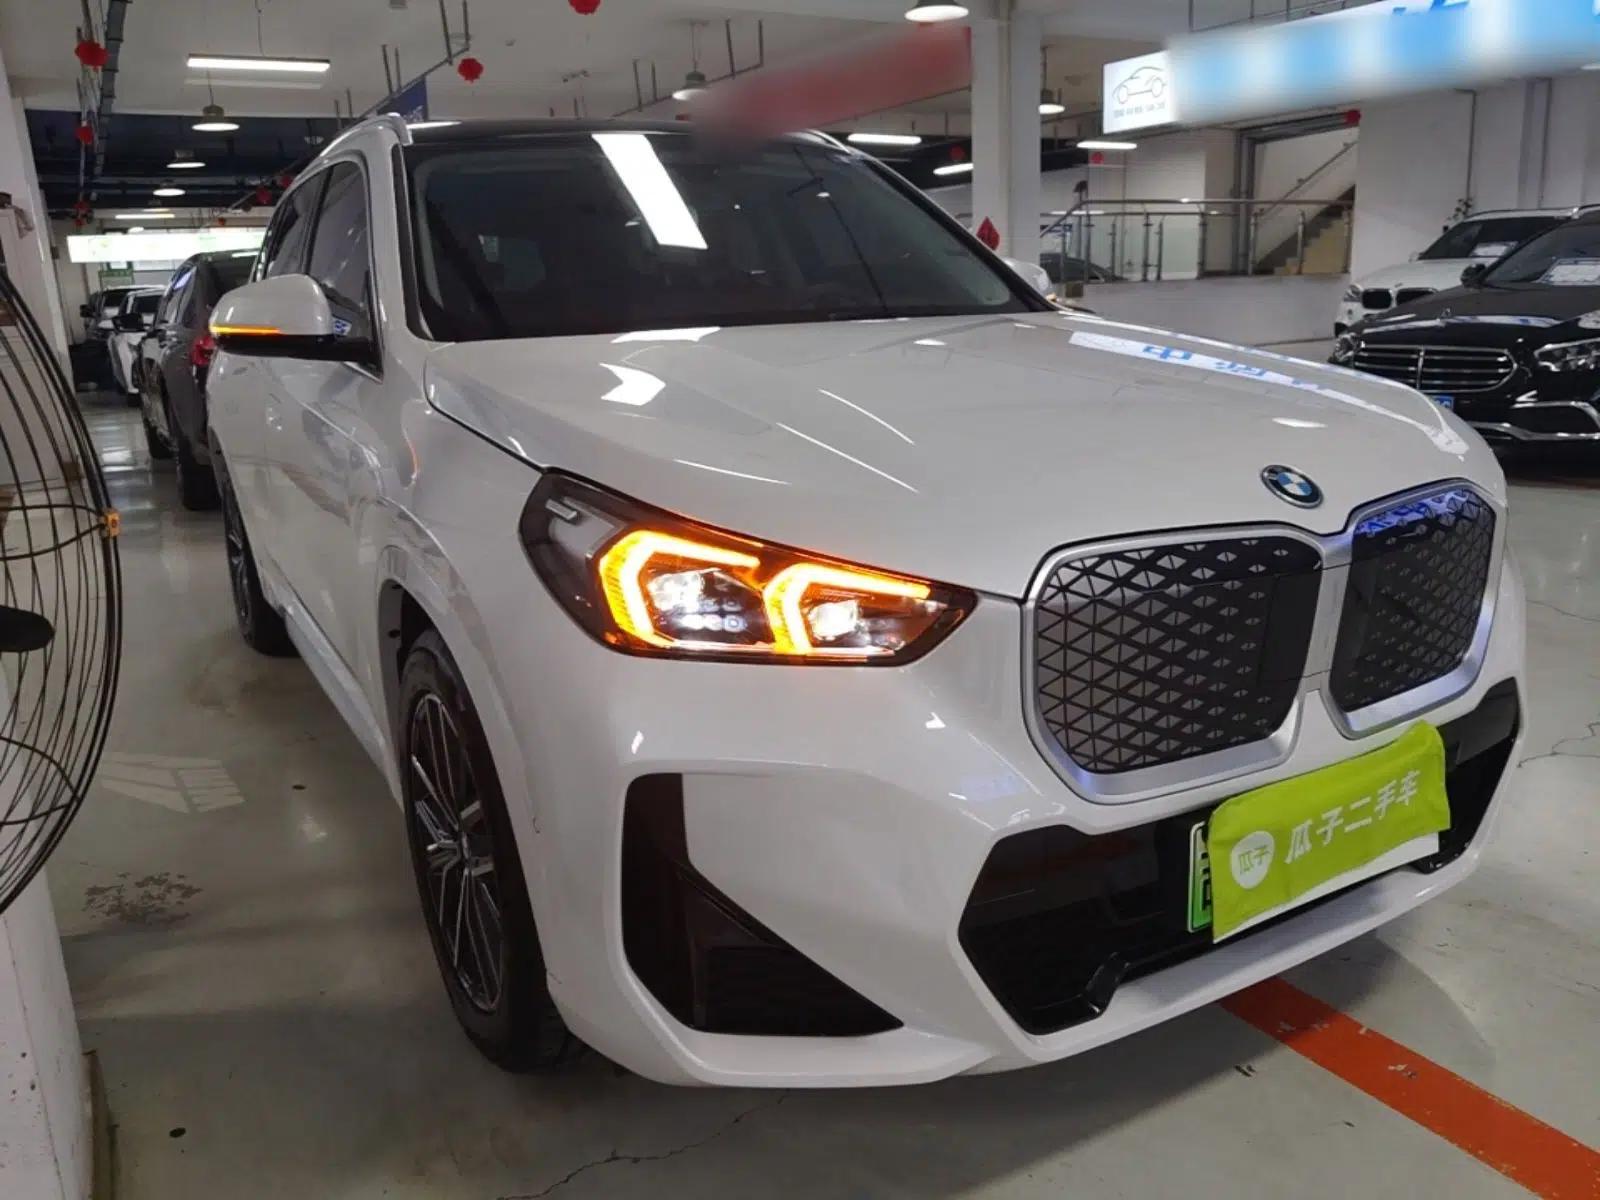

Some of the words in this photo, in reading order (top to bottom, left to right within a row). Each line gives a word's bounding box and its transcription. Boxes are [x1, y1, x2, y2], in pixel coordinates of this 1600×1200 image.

[1284, 770, 1420, 864] 瓜子二手车
